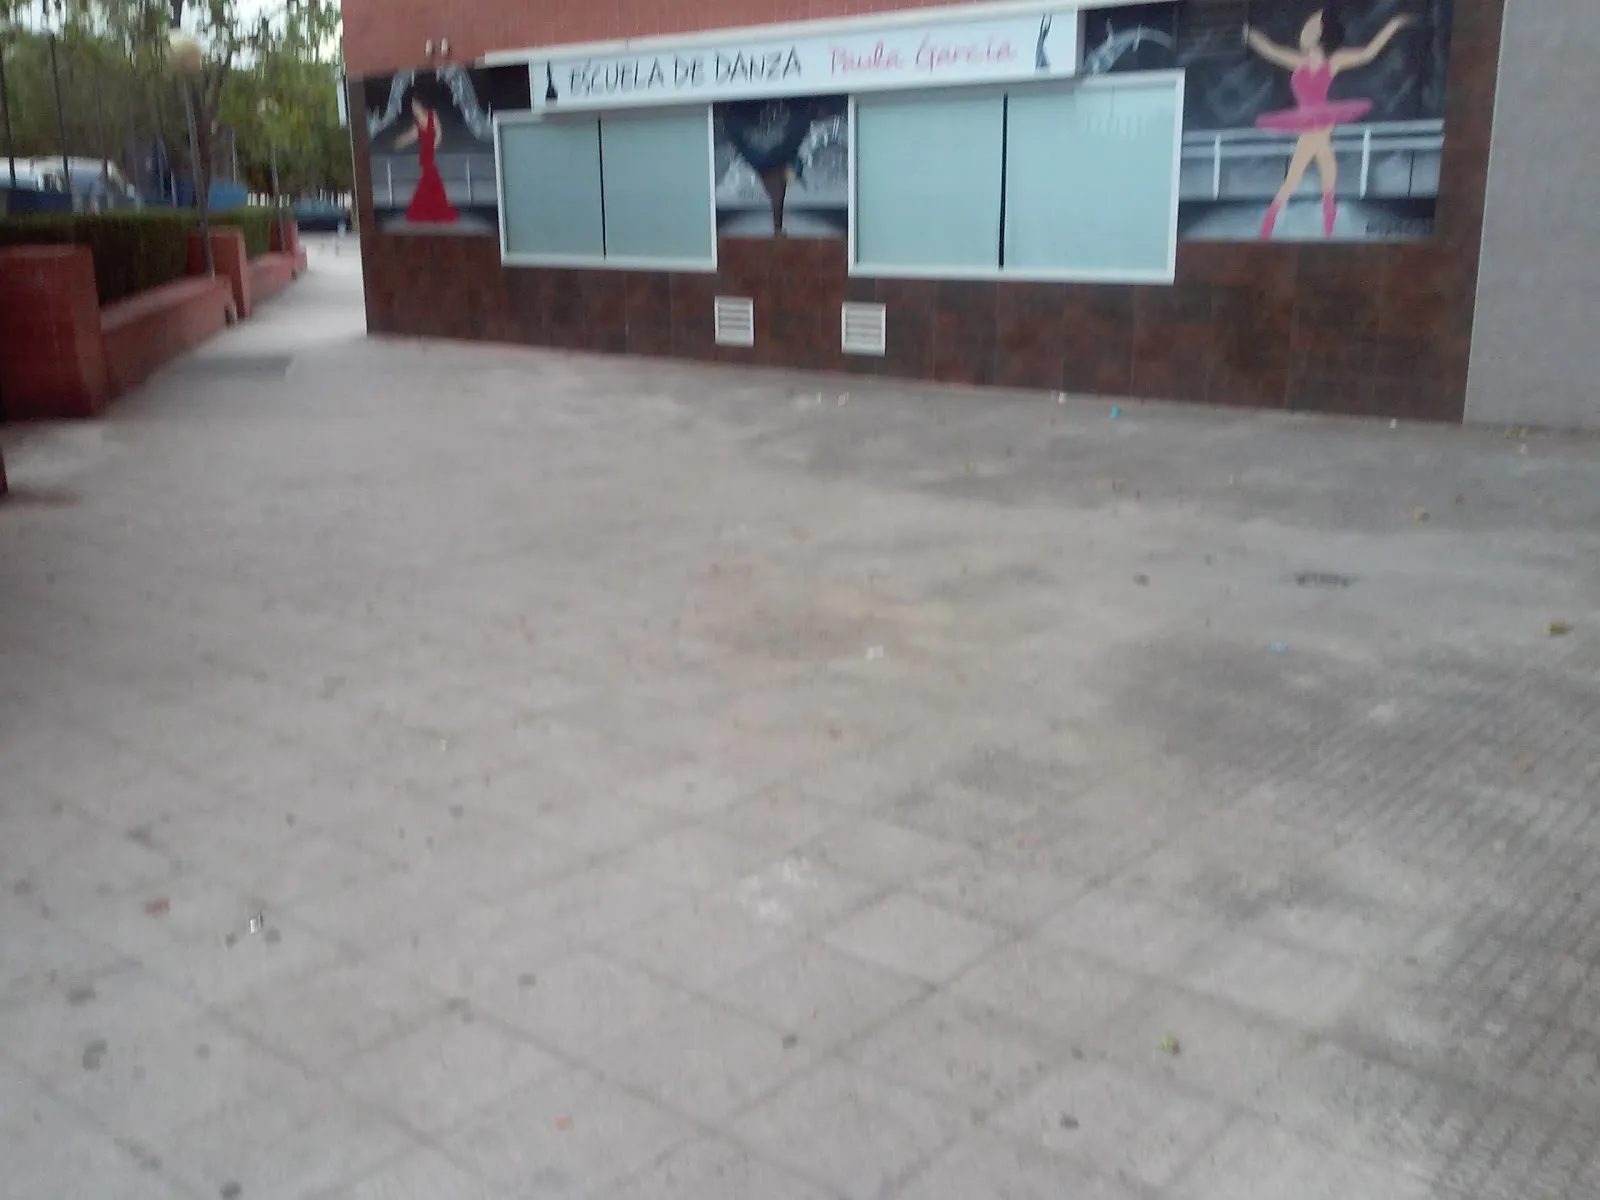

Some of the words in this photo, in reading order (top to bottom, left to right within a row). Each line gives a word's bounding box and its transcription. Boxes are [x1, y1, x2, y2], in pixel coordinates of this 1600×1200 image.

[569, 58, 664, 96] ESCUELA
[673, 54, 704, 89] DE
[715, 44, 802, 82] DANZA
[829, 39, 903, 76] Paula
